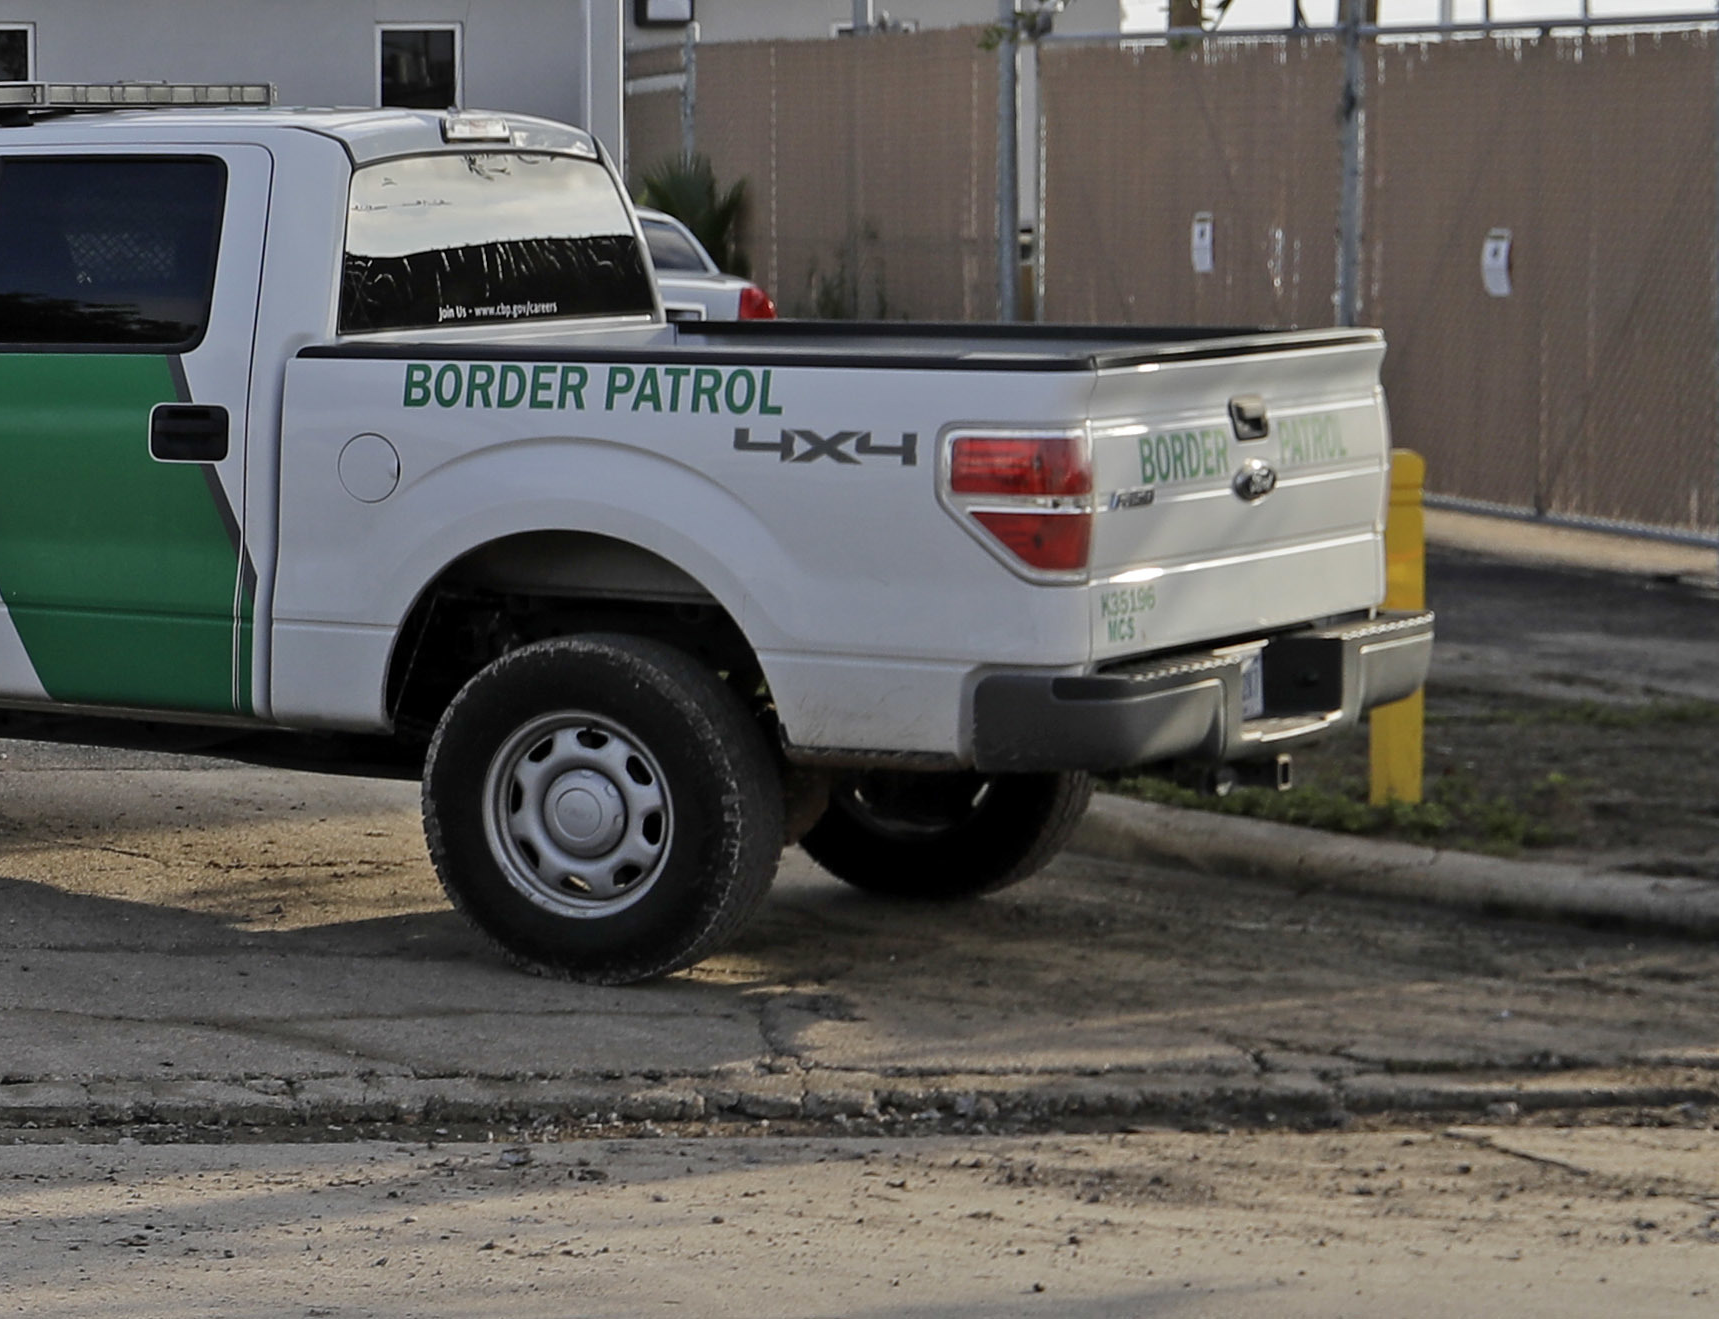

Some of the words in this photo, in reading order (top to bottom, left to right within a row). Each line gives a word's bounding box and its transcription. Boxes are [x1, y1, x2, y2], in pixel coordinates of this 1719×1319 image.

[438, 304, 455, 322] Join
[456, 306, 467, 318] Us
[474, 300, 558, 318] www.cbp.gov/careers
[403, 363, 587, 410] BORDER
[605, 366, 783, 415] PATROL
[1138, 429, 1230, 484] BORDER
[1277, 414, 1347, 465] PATROL
[1100, 585, 1156, 618] K35196
[1108, 617, 1135, 642] MCS
